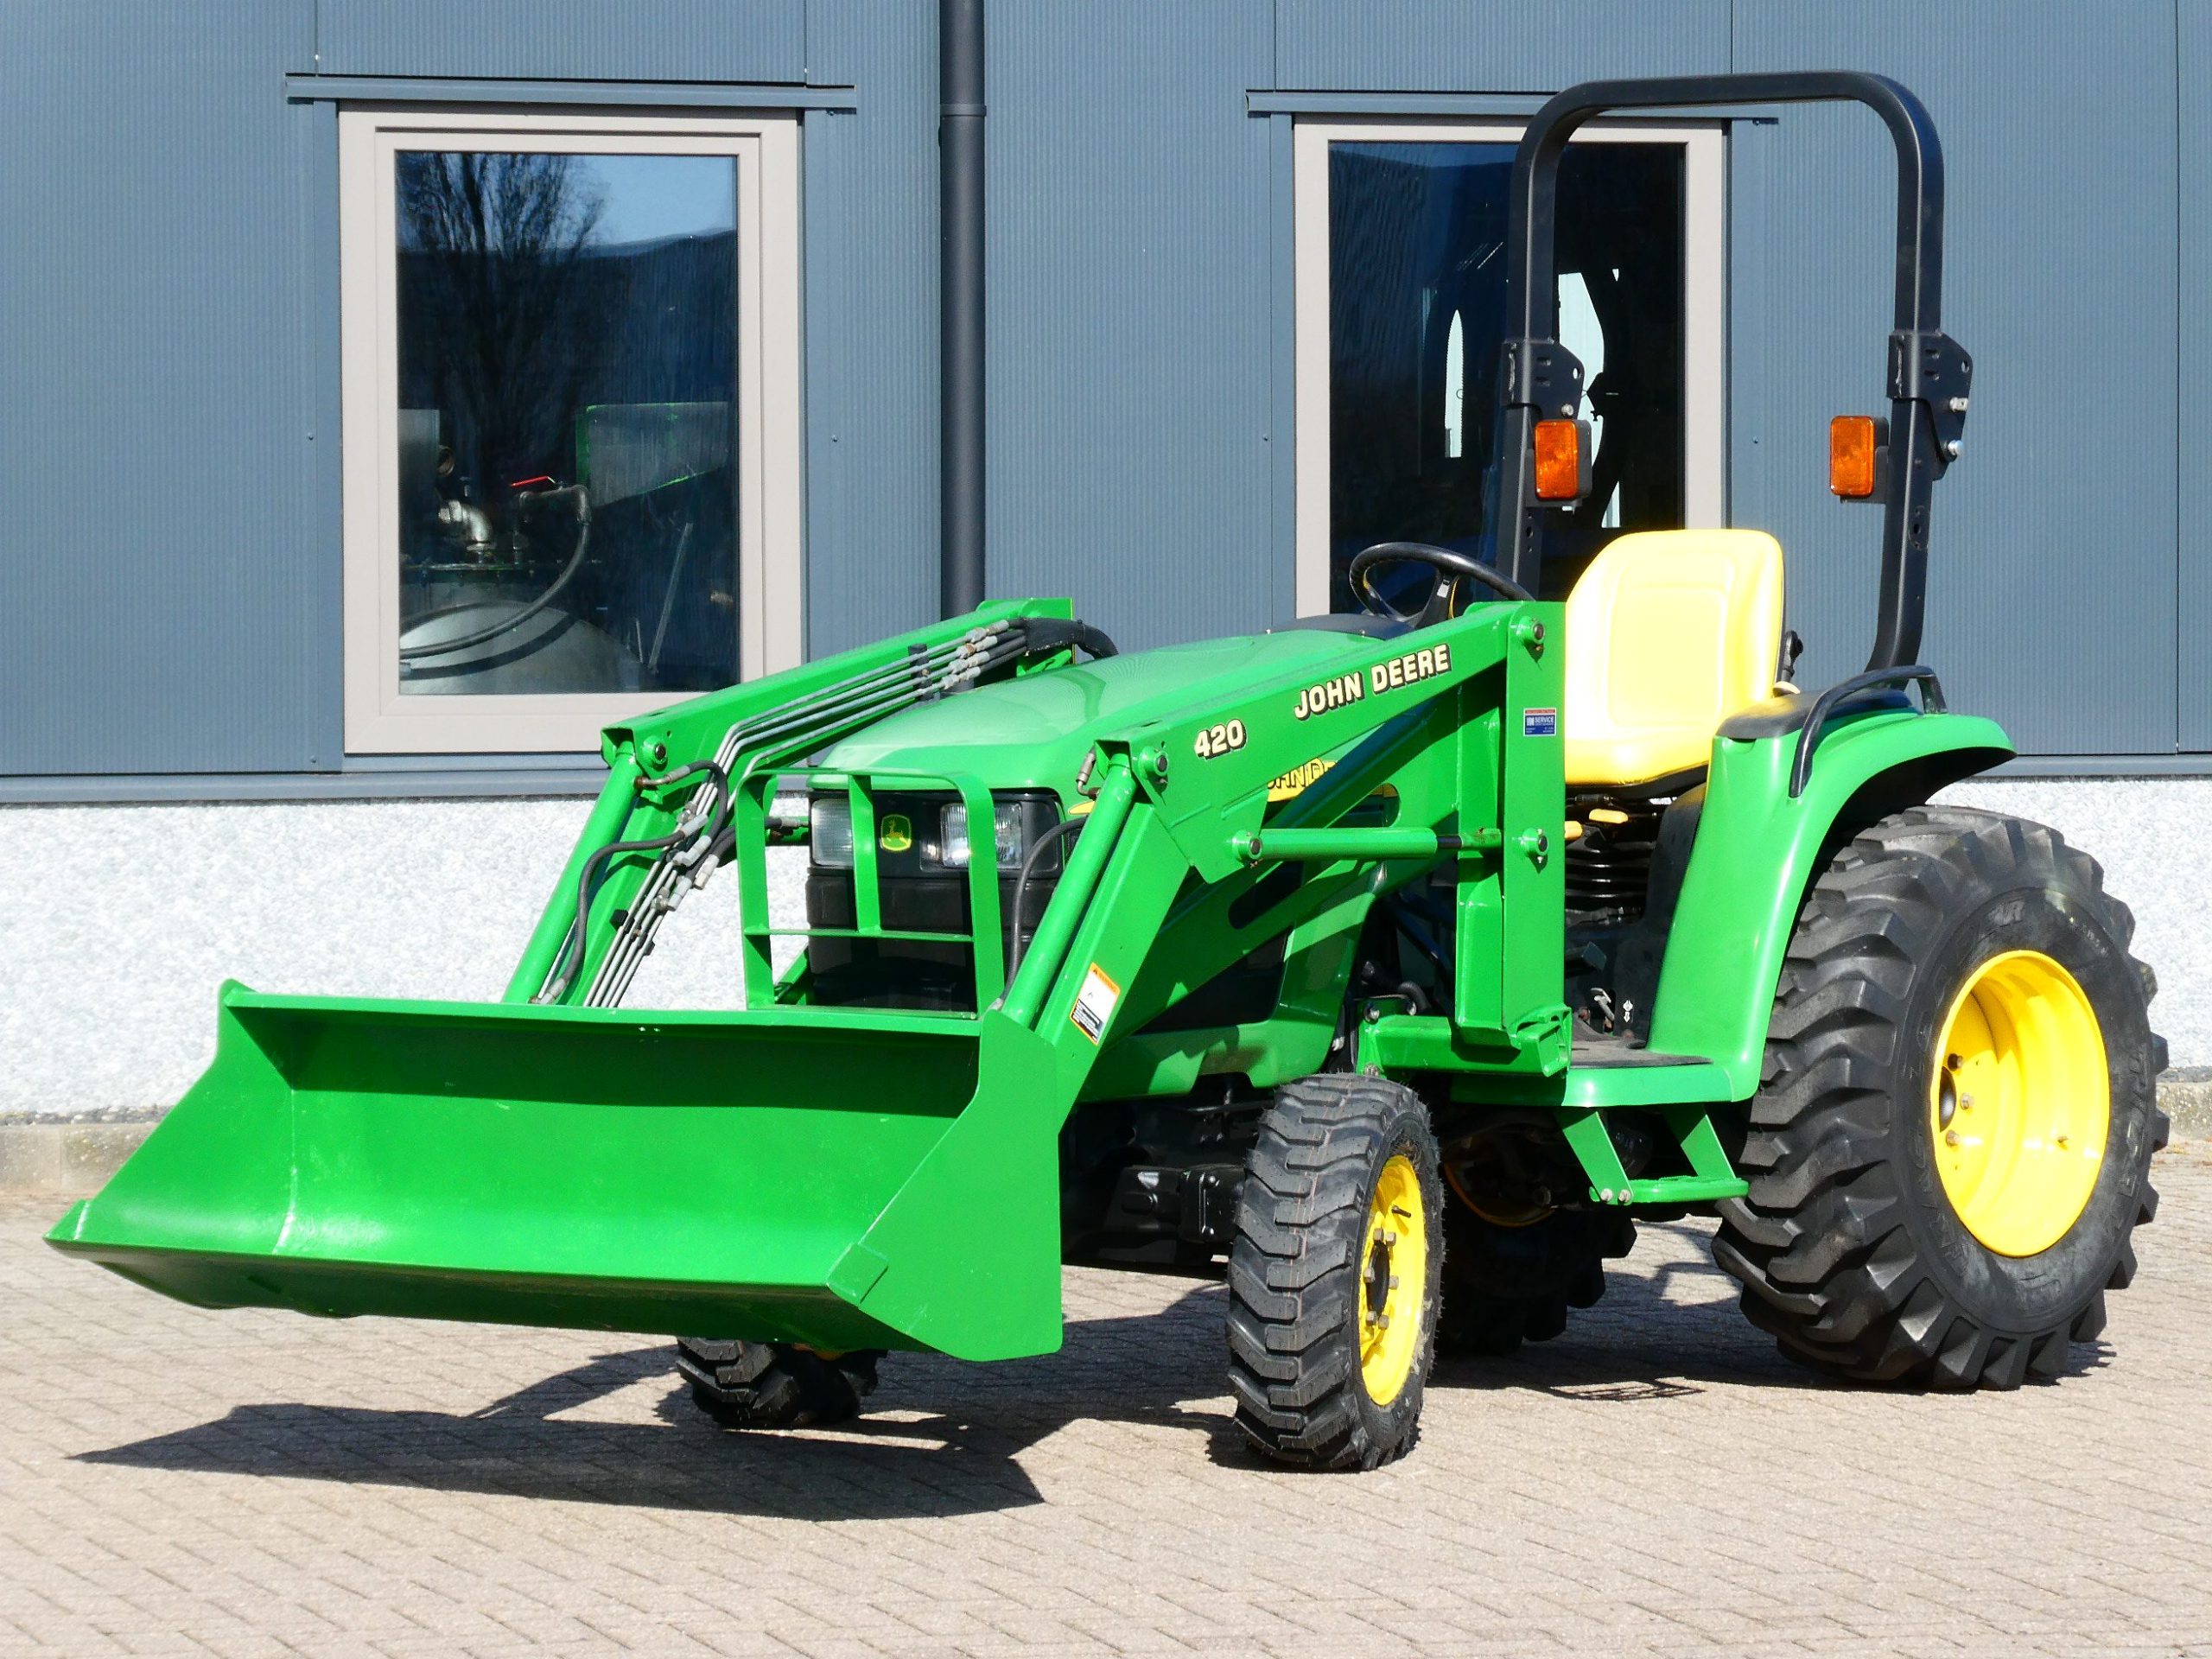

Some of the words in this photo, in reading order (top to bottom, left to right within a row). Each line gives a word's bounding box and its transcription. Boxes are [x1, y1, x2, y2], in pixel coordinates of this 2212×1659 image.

[1294, 671, 1364, 721] JOHN
[1370, 644, 1452, 695] DEERE
[1194, 719, 1247, 760] 420
